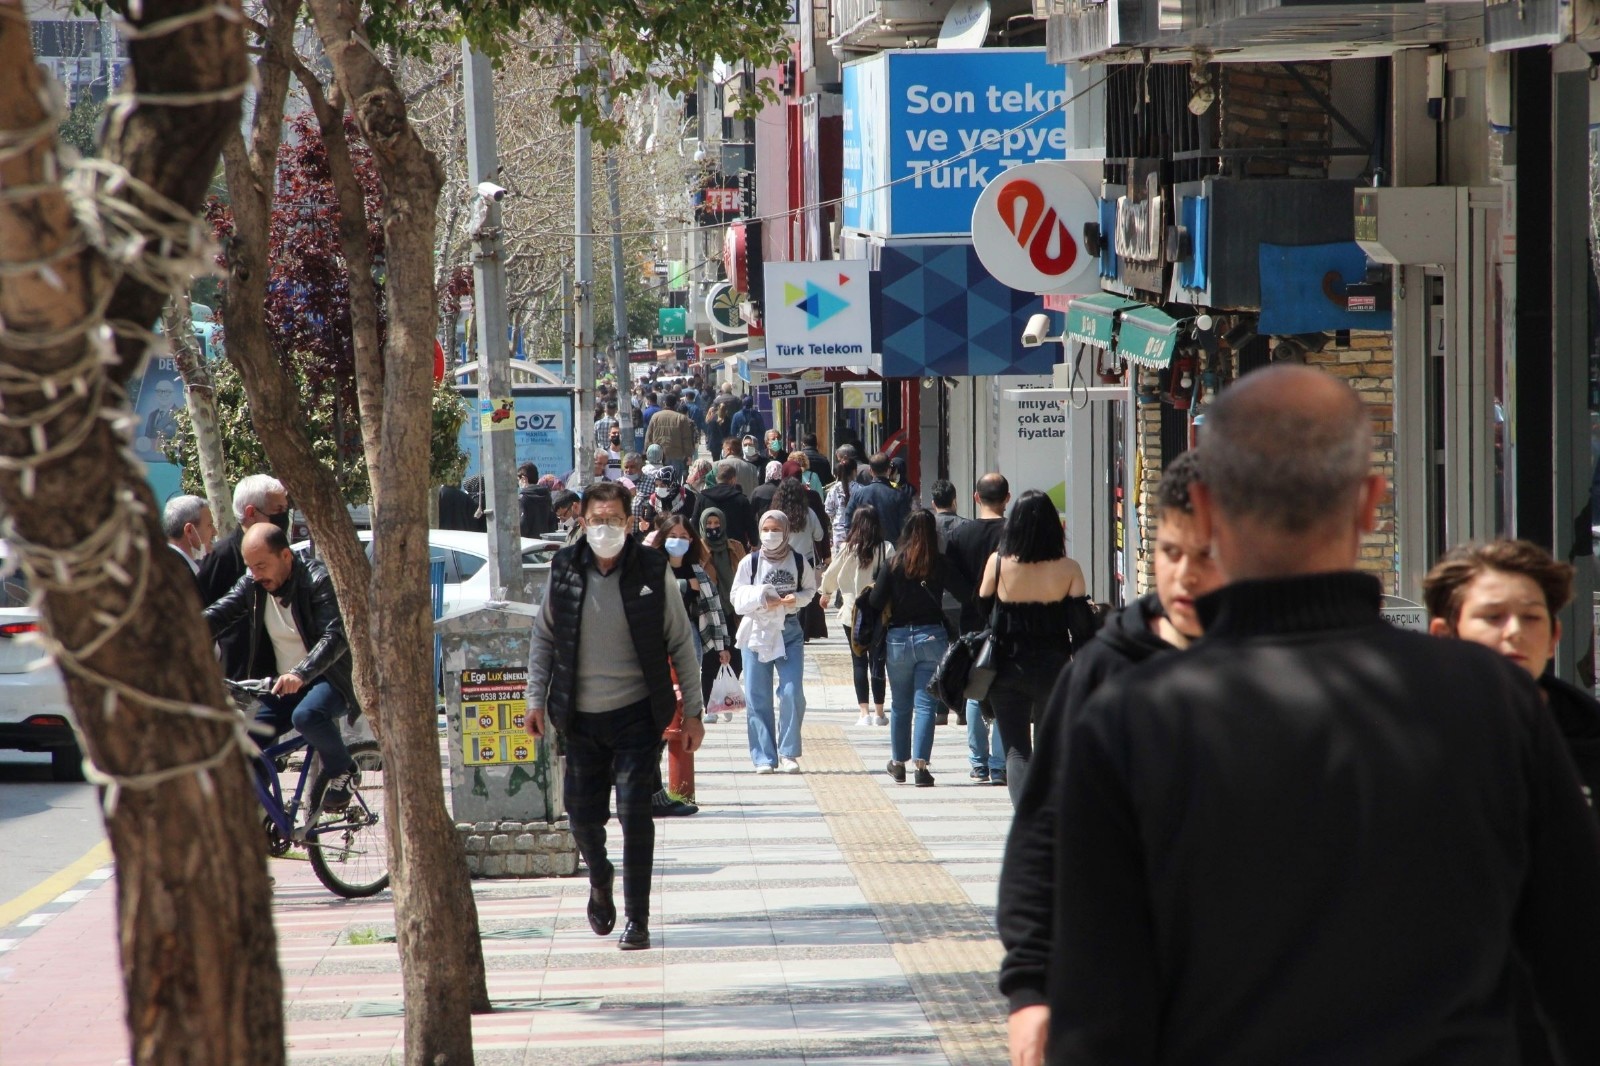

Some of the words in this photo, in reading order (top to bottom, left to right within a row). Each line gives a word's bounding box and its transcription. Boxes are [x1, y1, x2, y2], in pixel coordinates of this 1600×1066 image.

[906, 84, 975, 114] Son
[985, 82, 1066, 113] tekn
[905, 127, 949, 152] ve
[957, 127, 1066, 157] yepye
[906, 158, 990, 189] Türk
[776, 344, 804, 356] Türk
[808, 342, 863, 355] Telekom
[1018, 412, 1040, 426] çok
[1043, 414, 1065, 423] ava
[1017, 427, 1065, 440] fiyatlar
[471, 672, 486, 684] Ege
[480, 693, 497, 701] 0538
[498, 692, 511, 700] 324
[512, 691, 521, 699] 40
[480, 717, 492, 725] 90
